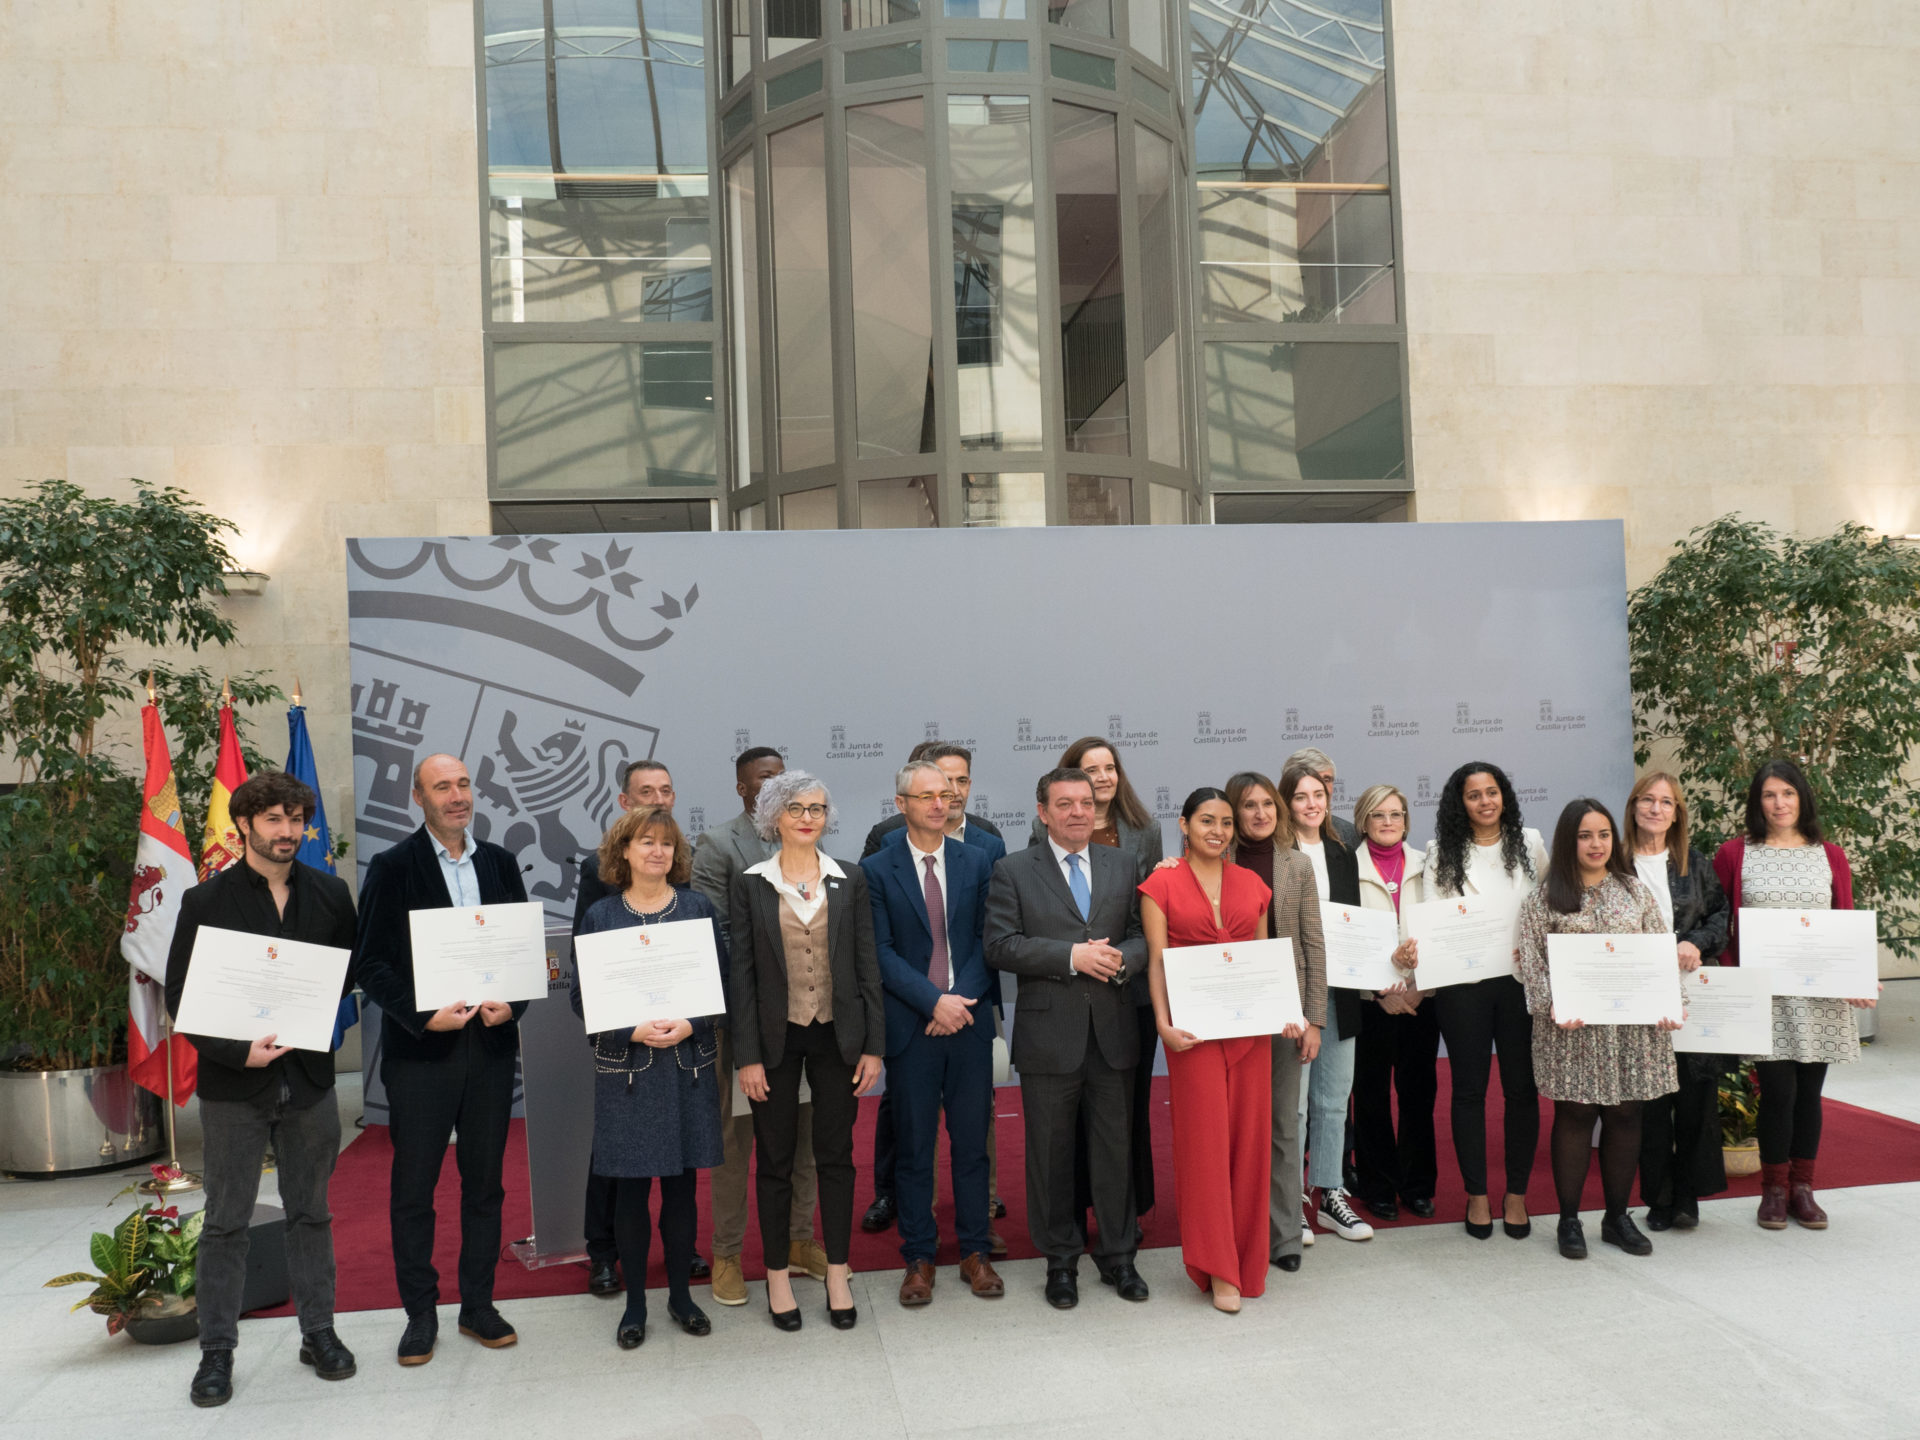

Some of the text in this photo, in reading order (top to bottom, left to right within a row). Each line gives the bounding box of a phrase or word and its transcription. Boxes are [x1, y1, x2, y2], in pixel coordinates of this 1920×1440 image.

[1125, 731, 1147, 739] Junta
[1281, 733, 1308, 741] Castilla
[1368, 729, 1394, 737] Castilla
[1193, 736, 1221, 744] Castilla
[847, 741, 884, 750] Junta de
[826, 751, 855, 759] Castilla
[863, 750, 884, 758] León
[548, 981, 570, 990] stilla
